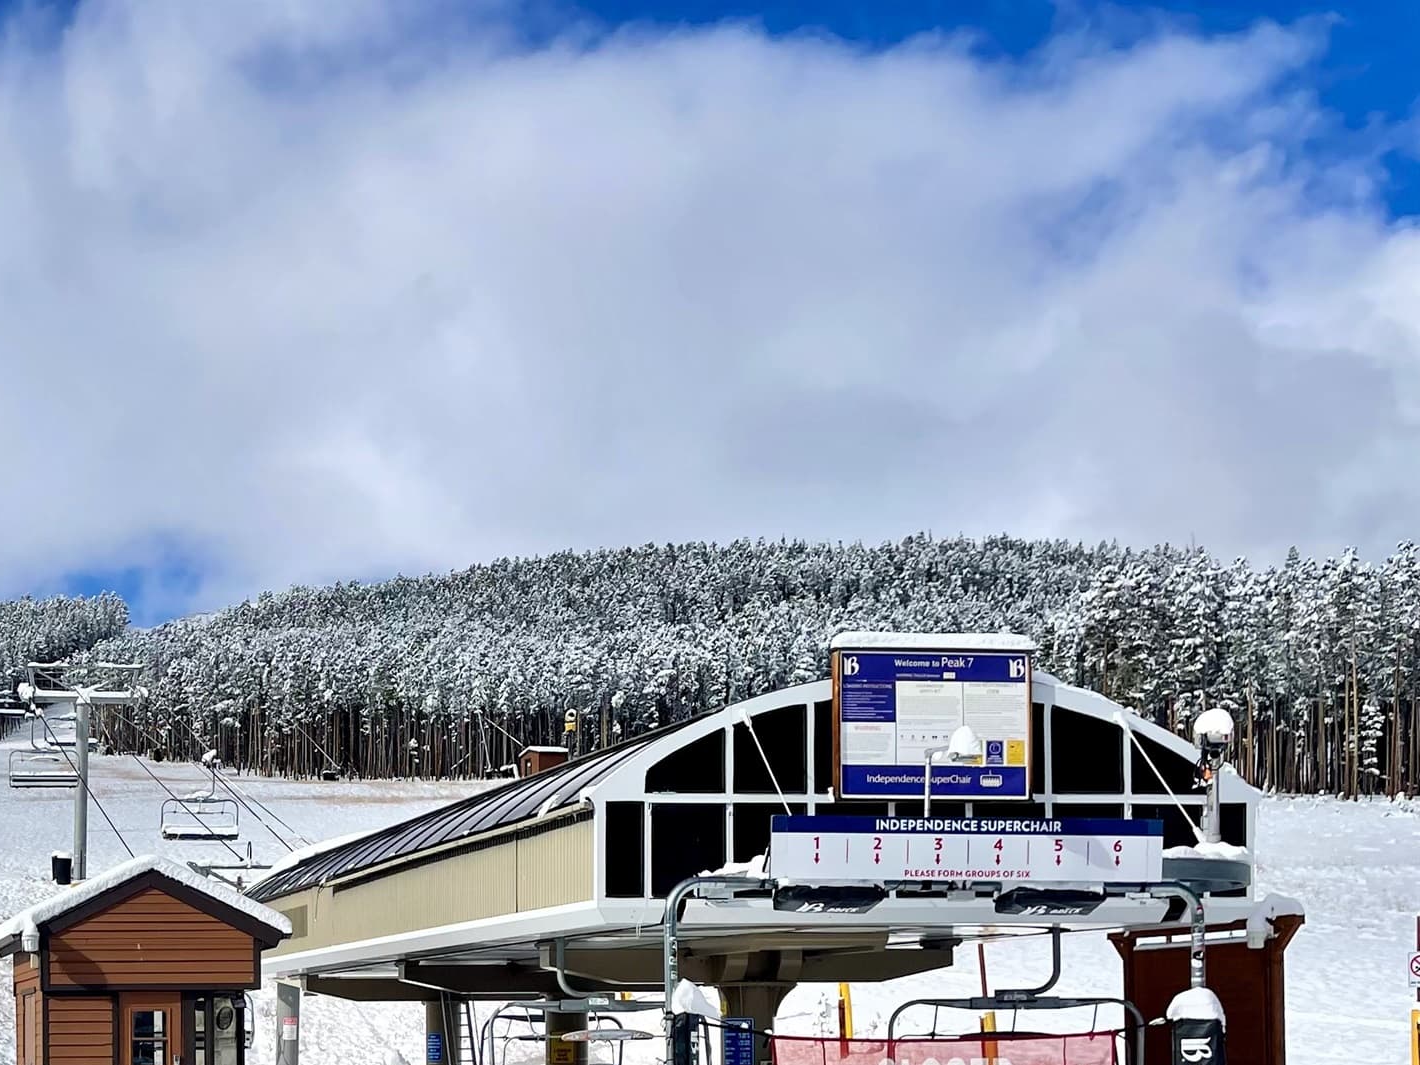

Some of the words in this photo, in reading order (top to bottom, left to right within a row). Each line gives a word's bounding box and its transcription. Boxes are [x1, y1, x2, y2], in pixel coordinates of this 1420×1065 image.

[894, 659, 930, 667] Welcome
[941, 656, 966, 668] Peak
[967, 657, 974, 668] 7
[866, 774, 926, 786] Independence
[926, 774, 972, 786] uperChair
[875, 819, 978, 832] INDEPENDENCE
[980, 820, 1062, 833] SUPERCHAIR
[813, 836, 820, 850] 1
[873, 837, 882, 850] 2
[934, 838, 943, 850] 3
[993, 838, 1003, 851] 4
[1054, 839, 1063, 851] 5
[1113, 840, 1122, 852] 6
[904, 869, 936, 877] PLEASE
[965, 870, 1000, 878] GROUPS
[1002, 870, 1014, 878] OF
